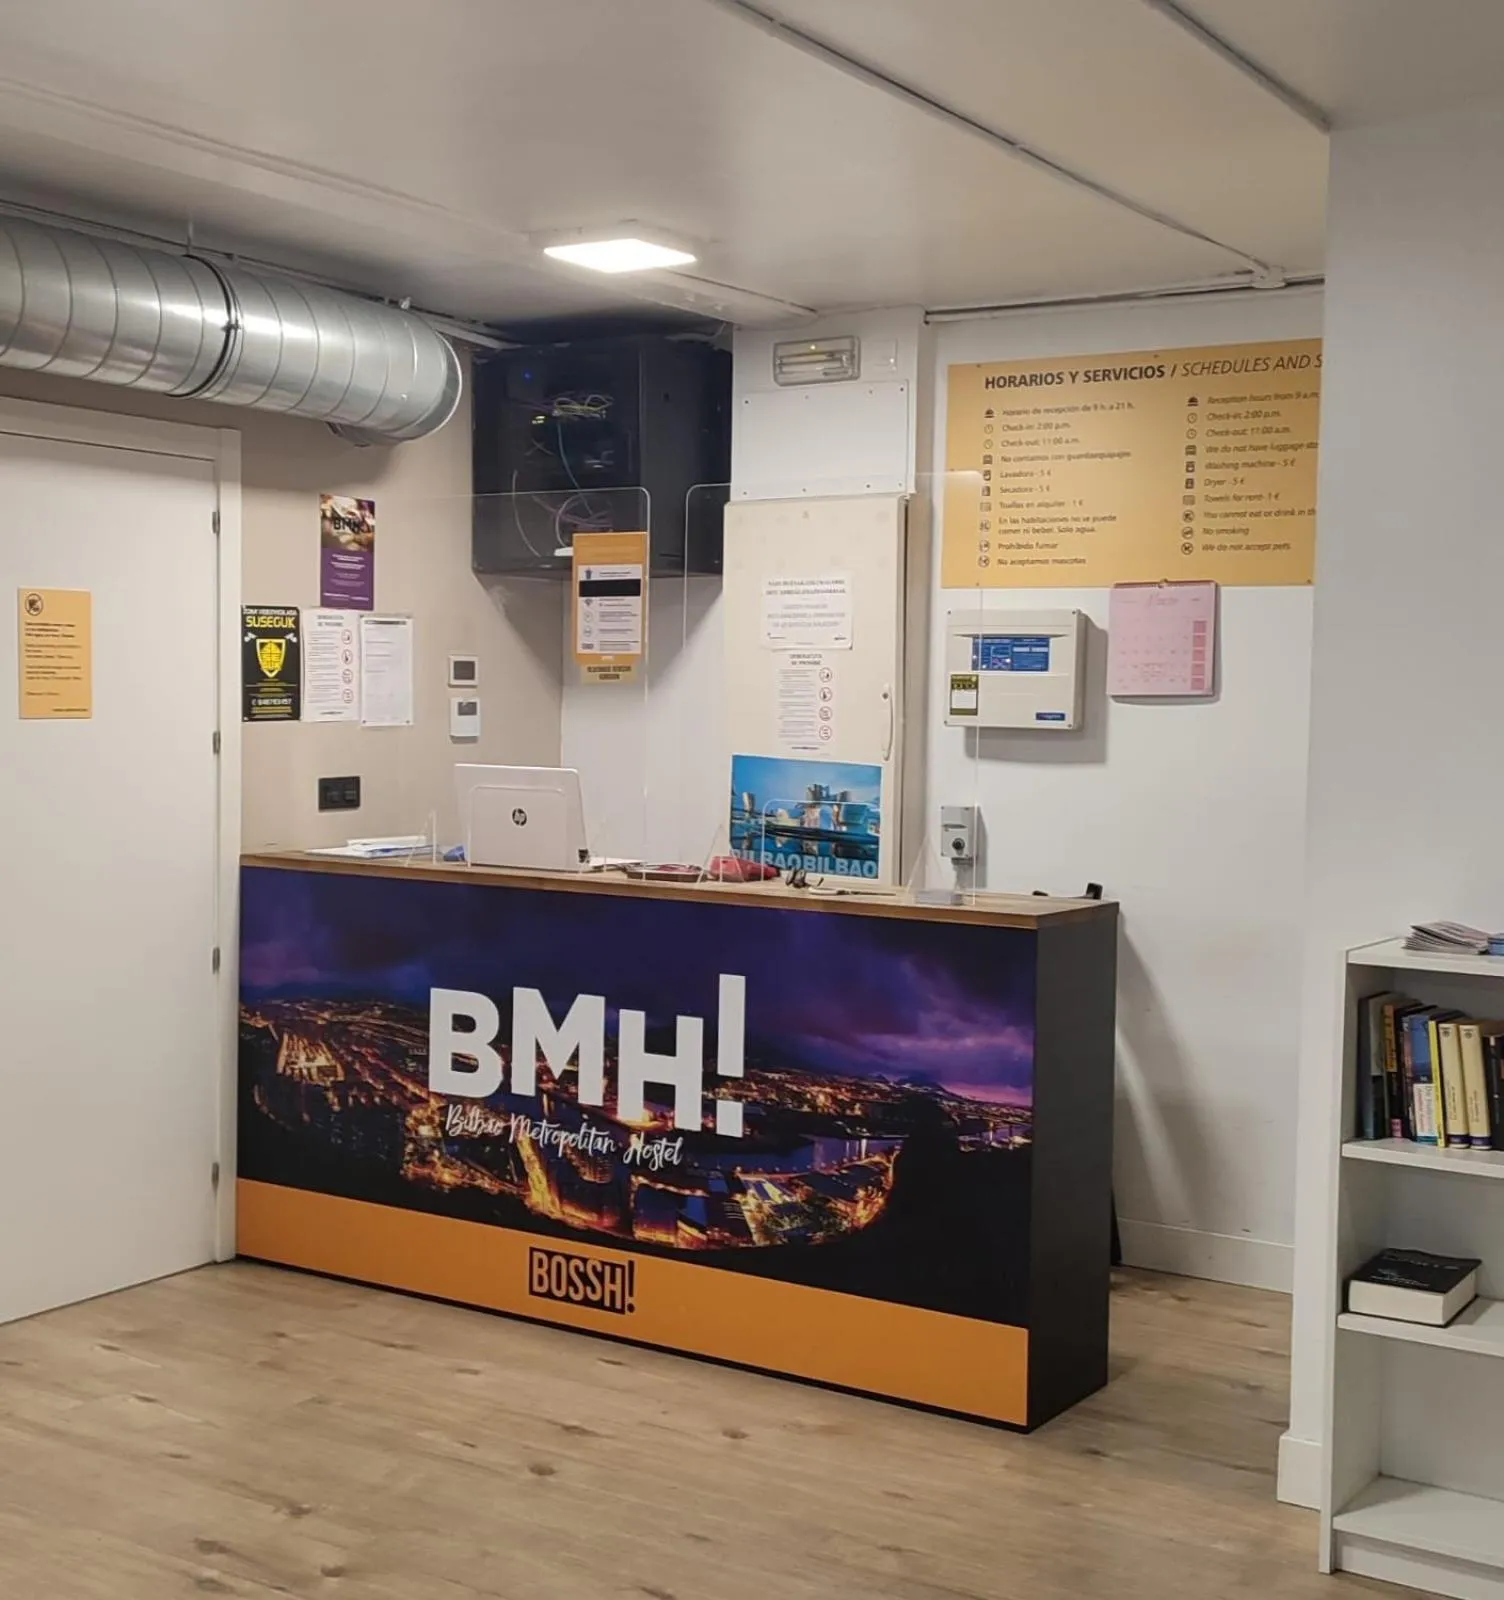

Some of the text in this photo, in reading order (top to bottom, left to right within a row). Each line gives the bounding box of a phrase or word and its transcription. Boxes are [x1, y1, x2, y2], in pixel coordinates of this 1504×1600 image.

[984, 373, 1064, 389] HORARIOS
[1069, 371, 1079, 383] Y
[1082, 364, 1165, 383] SERVICIOS
[1170, 364, 1177, 377] /
[1181, 357, 1270, 377] SCHEDULES
[1273, 355, 1311, 371] AND
[429, 973, 746, 1138] BMH!
[446, 1103, 684, 1172] Bilbao Metropolitan Hostel
[529, 1247, 635, 1315] BOSSH!
